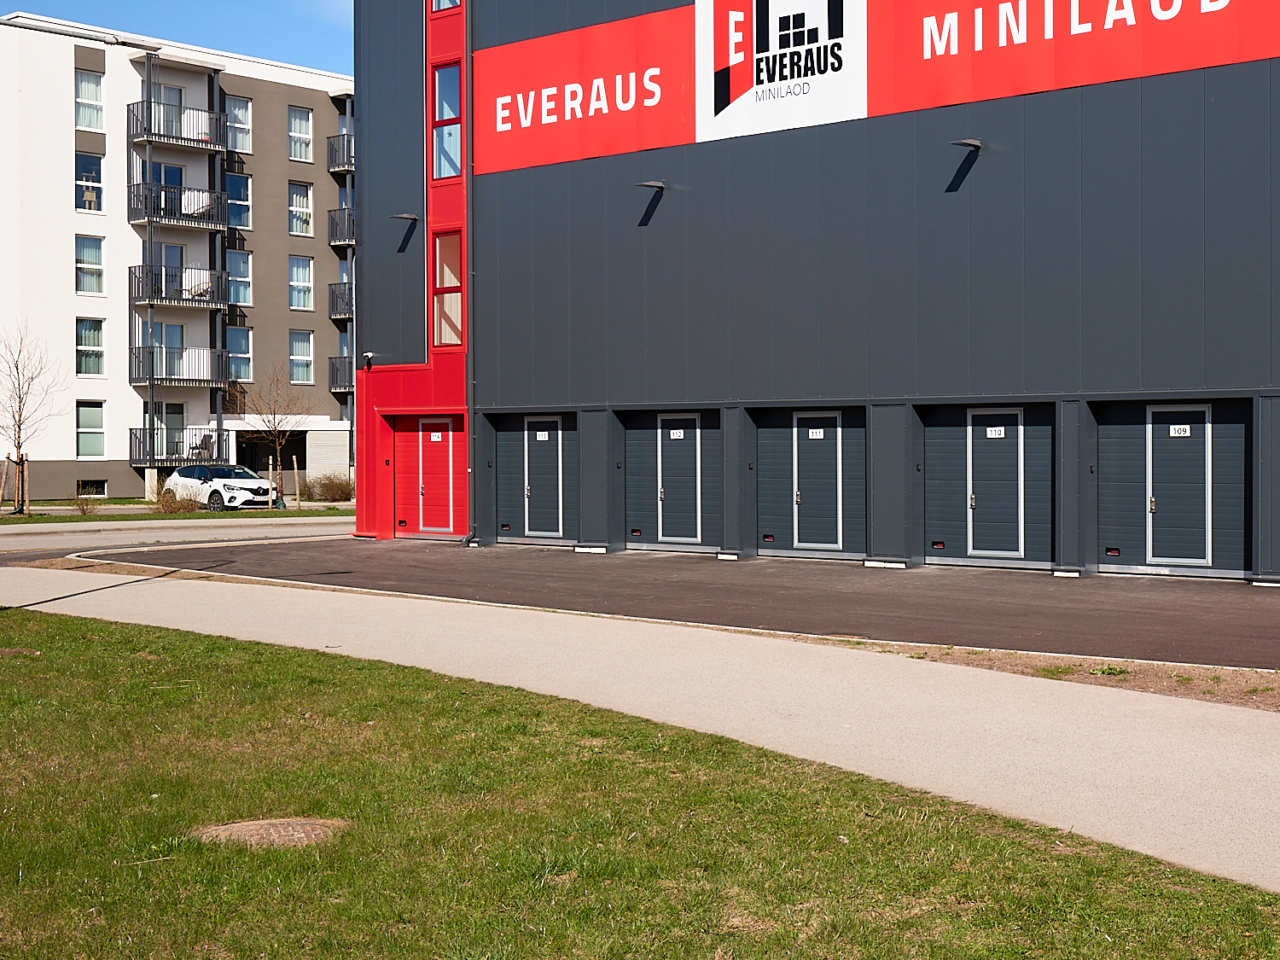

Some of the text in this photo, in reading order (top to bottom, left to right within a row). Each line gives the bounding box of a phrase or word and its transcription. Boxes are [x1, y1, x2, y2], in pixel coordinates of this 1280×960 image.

[728, 10, 745, 67] E
[755, 42, 843, 86] EVERAUS
[496, 67, 662, 132] EVERAUS
[755, 82, 811, 102] MINILAOD
[1173, 427, 1187, 435] 109
